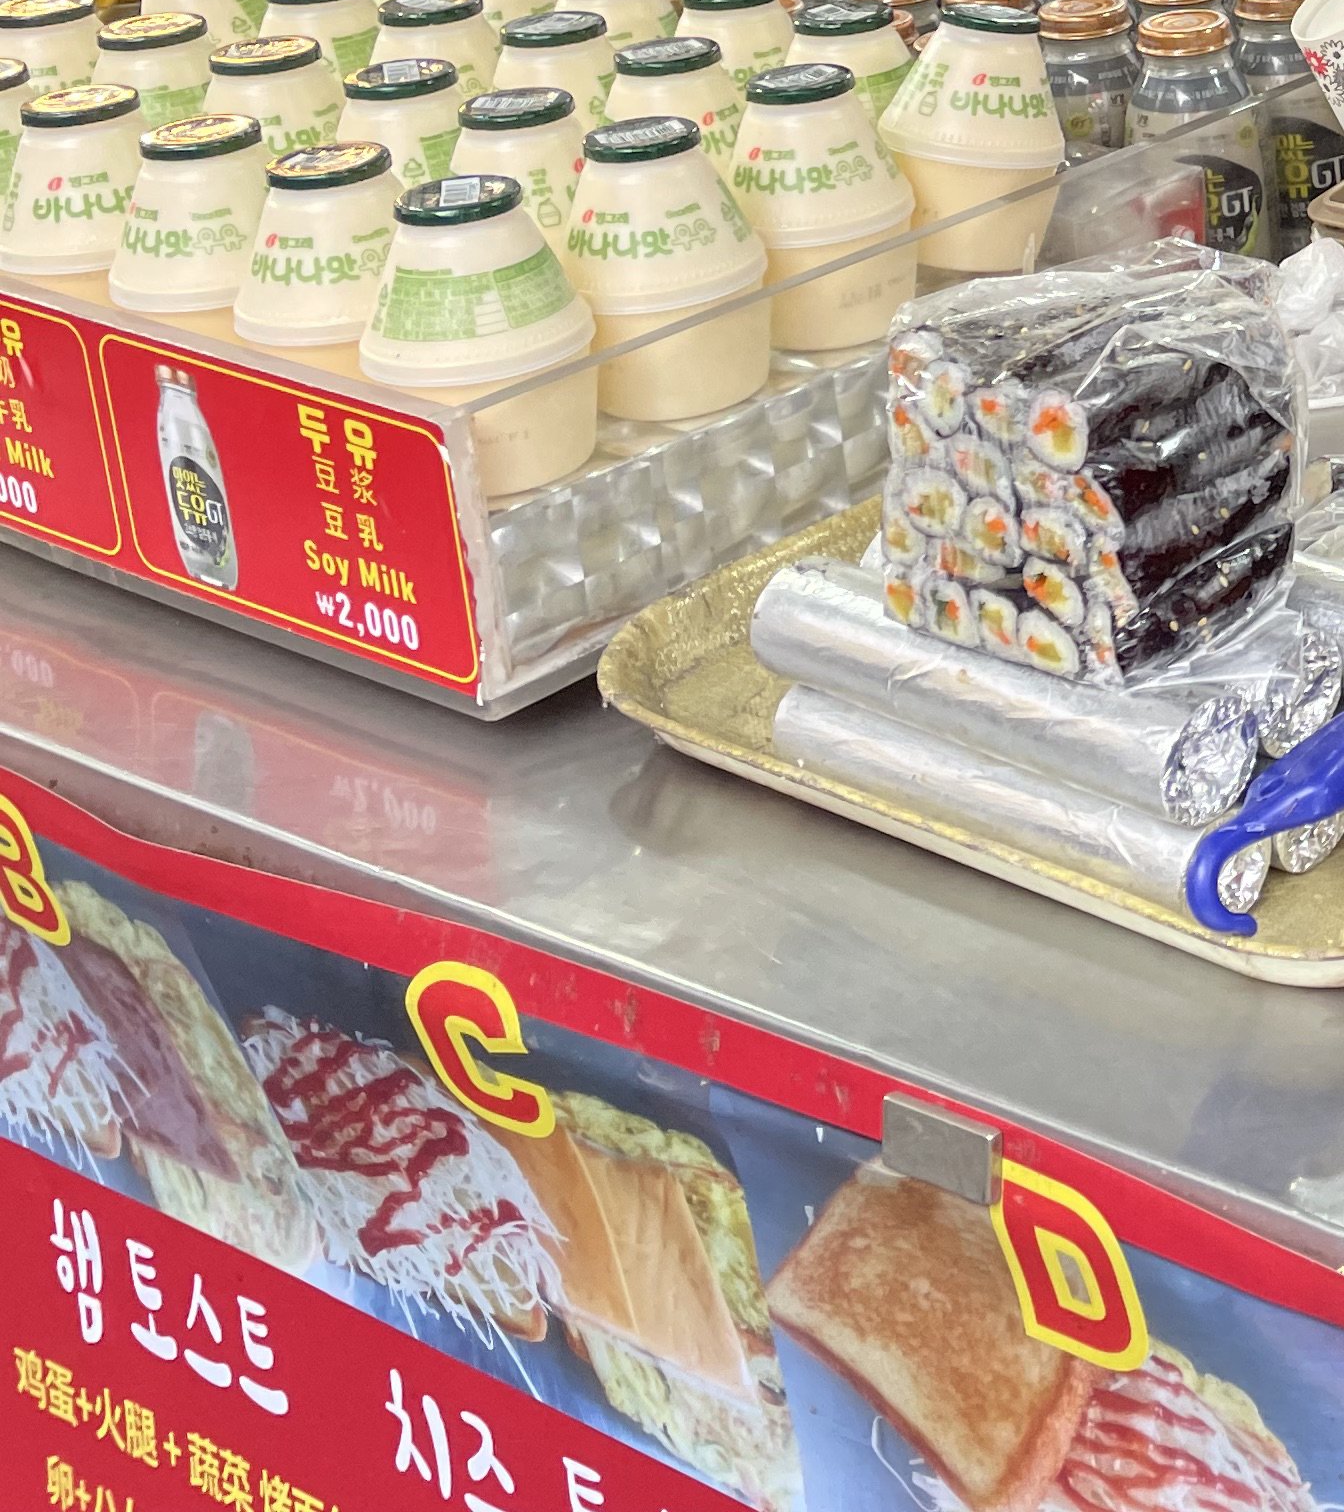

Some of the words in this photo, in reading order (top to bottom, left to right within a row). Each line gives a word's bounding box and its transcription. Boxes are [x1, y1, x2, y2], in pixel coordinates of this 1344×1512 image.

[1221, 186, 1254, 217] GT
[1311, 154, 1344, 189] GT
[5, 437, 55, 479] Milk
[297, 403, 378, 471] 두유
[311, 454, 379, 506] 豆浆
[320, 501, 385, 552] 豆乳
[304, 539, 350, 587] Soy
[357, 557, 418, 605] Milk
[315, 590, 420, 652] ₩2,000
[404, 959, 557, 1139] C
[990, 1157, 1151, 1372] D
[50, 1197, 103, 1344] 햄
[128, 1237, 289, 1416] 토스트
